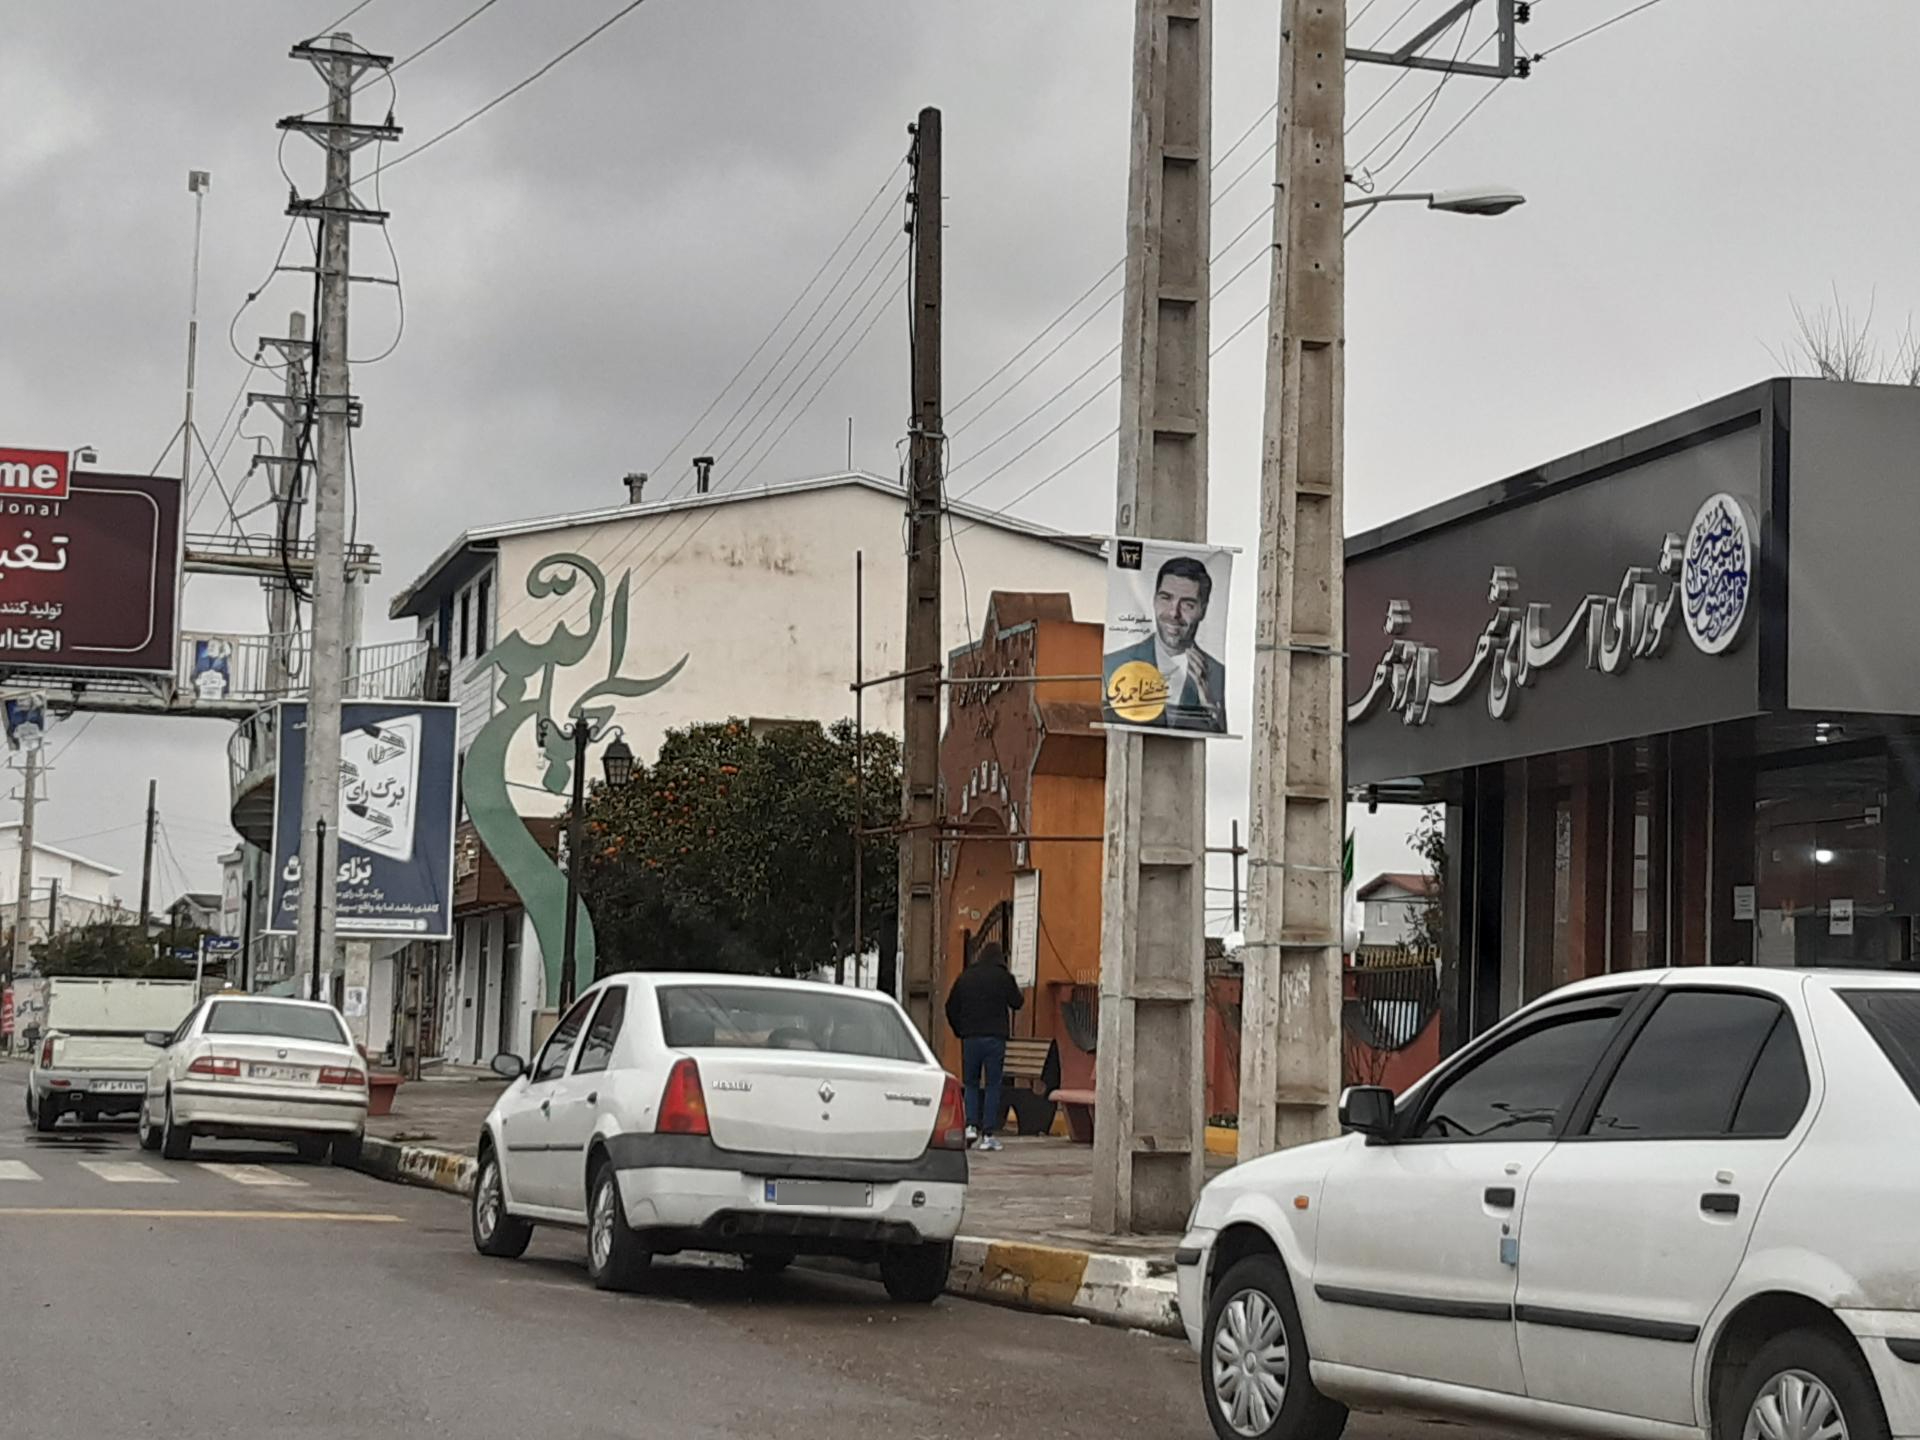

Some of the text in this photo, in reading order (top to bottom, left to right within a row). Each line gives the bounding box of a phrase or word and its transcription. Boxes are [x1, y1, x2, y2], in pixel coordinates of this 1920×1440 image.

[30, 601, 63, 620] تولید
[1418, 566, 1519, 725] شهر
[1488, 593, 1606, 720] اسلامی
[1599, 531, 1683, 673] شورای
[370, 777, 405, 808] برگ
